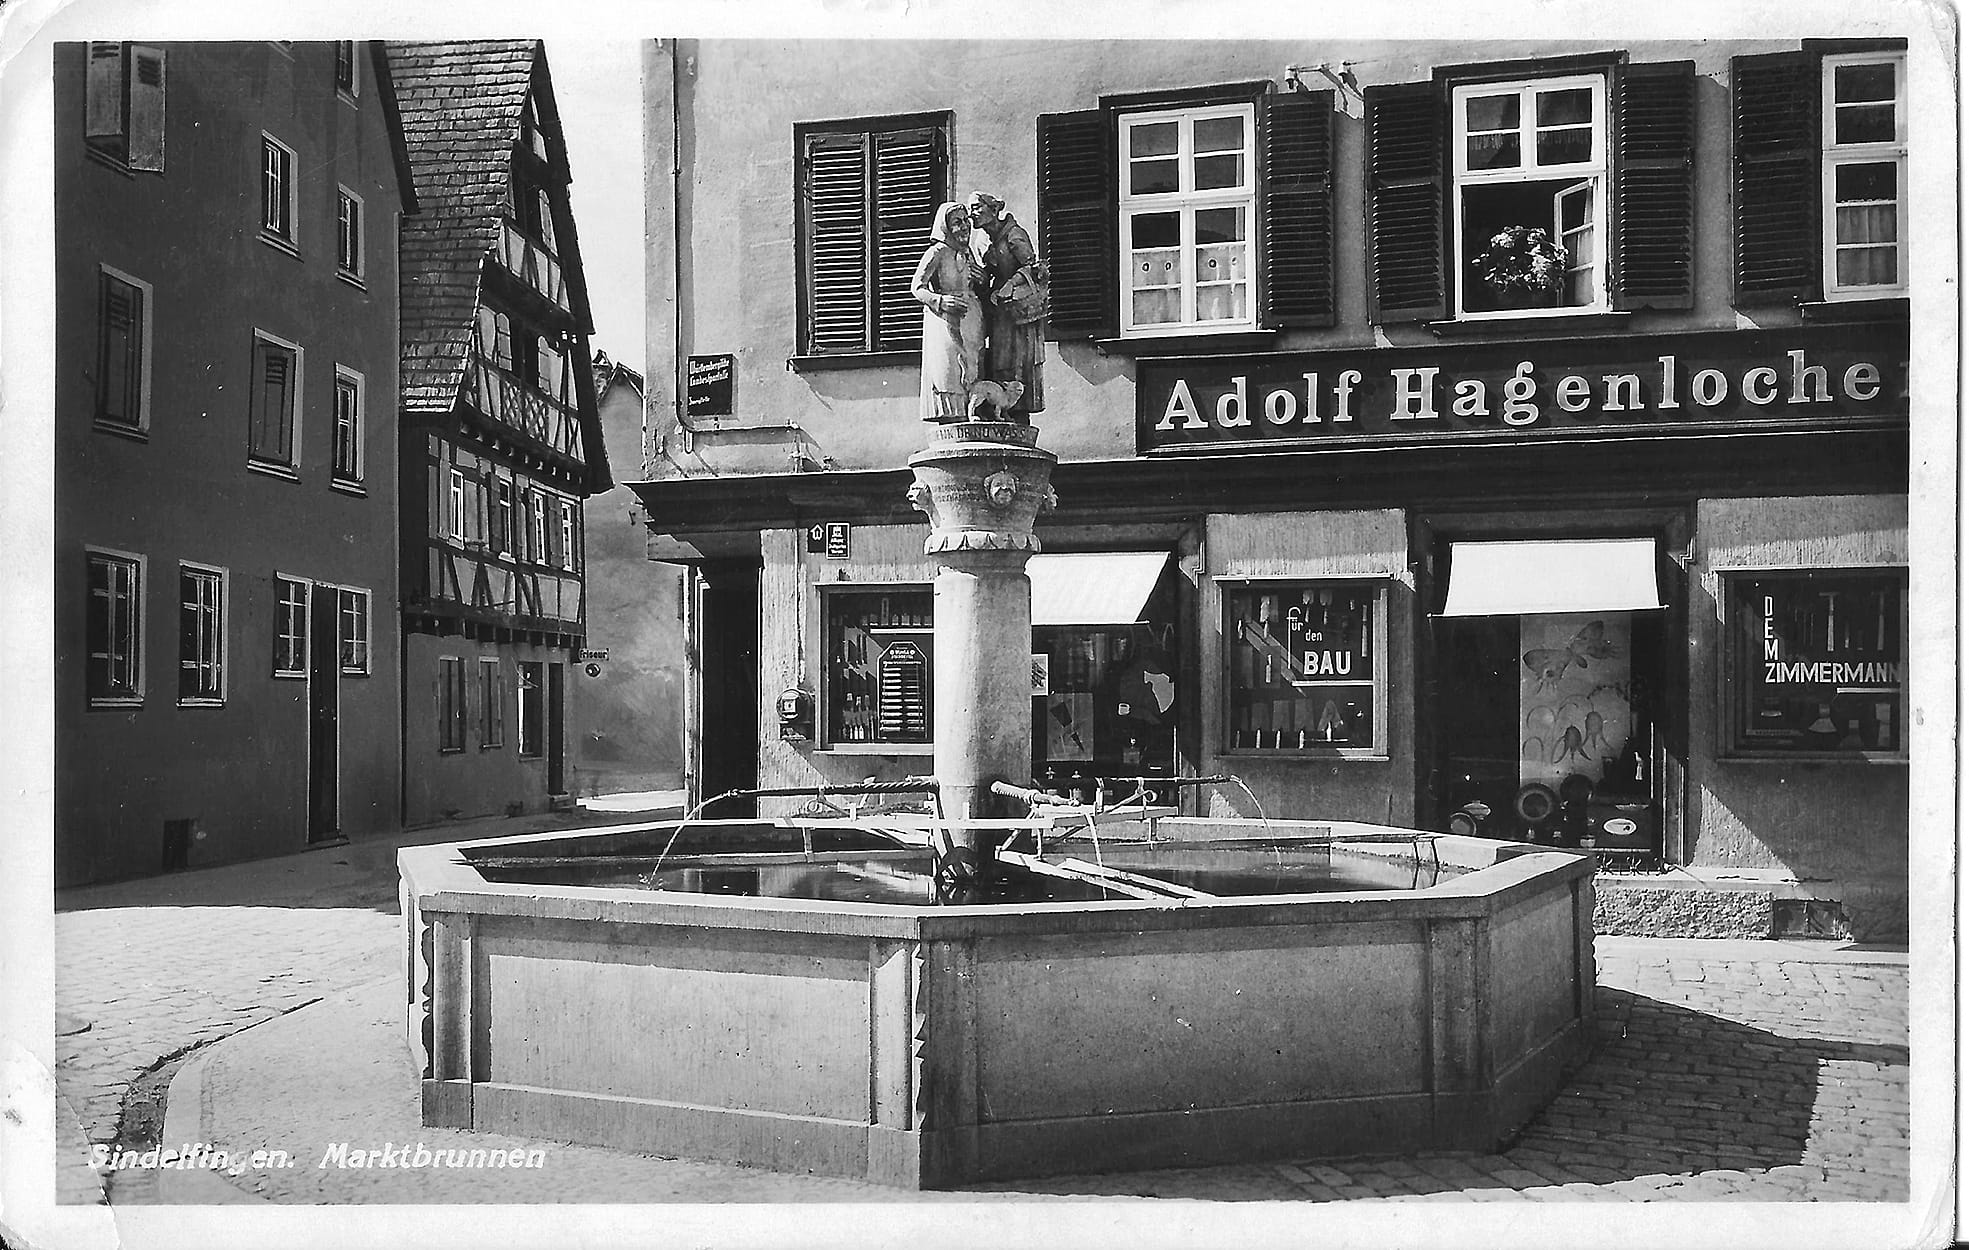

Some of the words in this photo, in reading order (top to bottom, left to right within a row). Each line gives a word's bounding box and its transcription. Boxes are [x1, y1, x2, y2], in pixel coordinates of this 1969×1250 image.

[1155, 369, 1362, 431] Adolf
[1390, 349, 1909, 426] Hagenloche
[1286, 606, 1304, 669] für
[1305, 629, 1323, 641] den
[1764, 596, 1779, 660] DEM
[580, 649, 608, 659] Friseur
[1303, 650, 1351, 675] BAU
[1765, 662, 1901, 683] ZIMMERMANN
